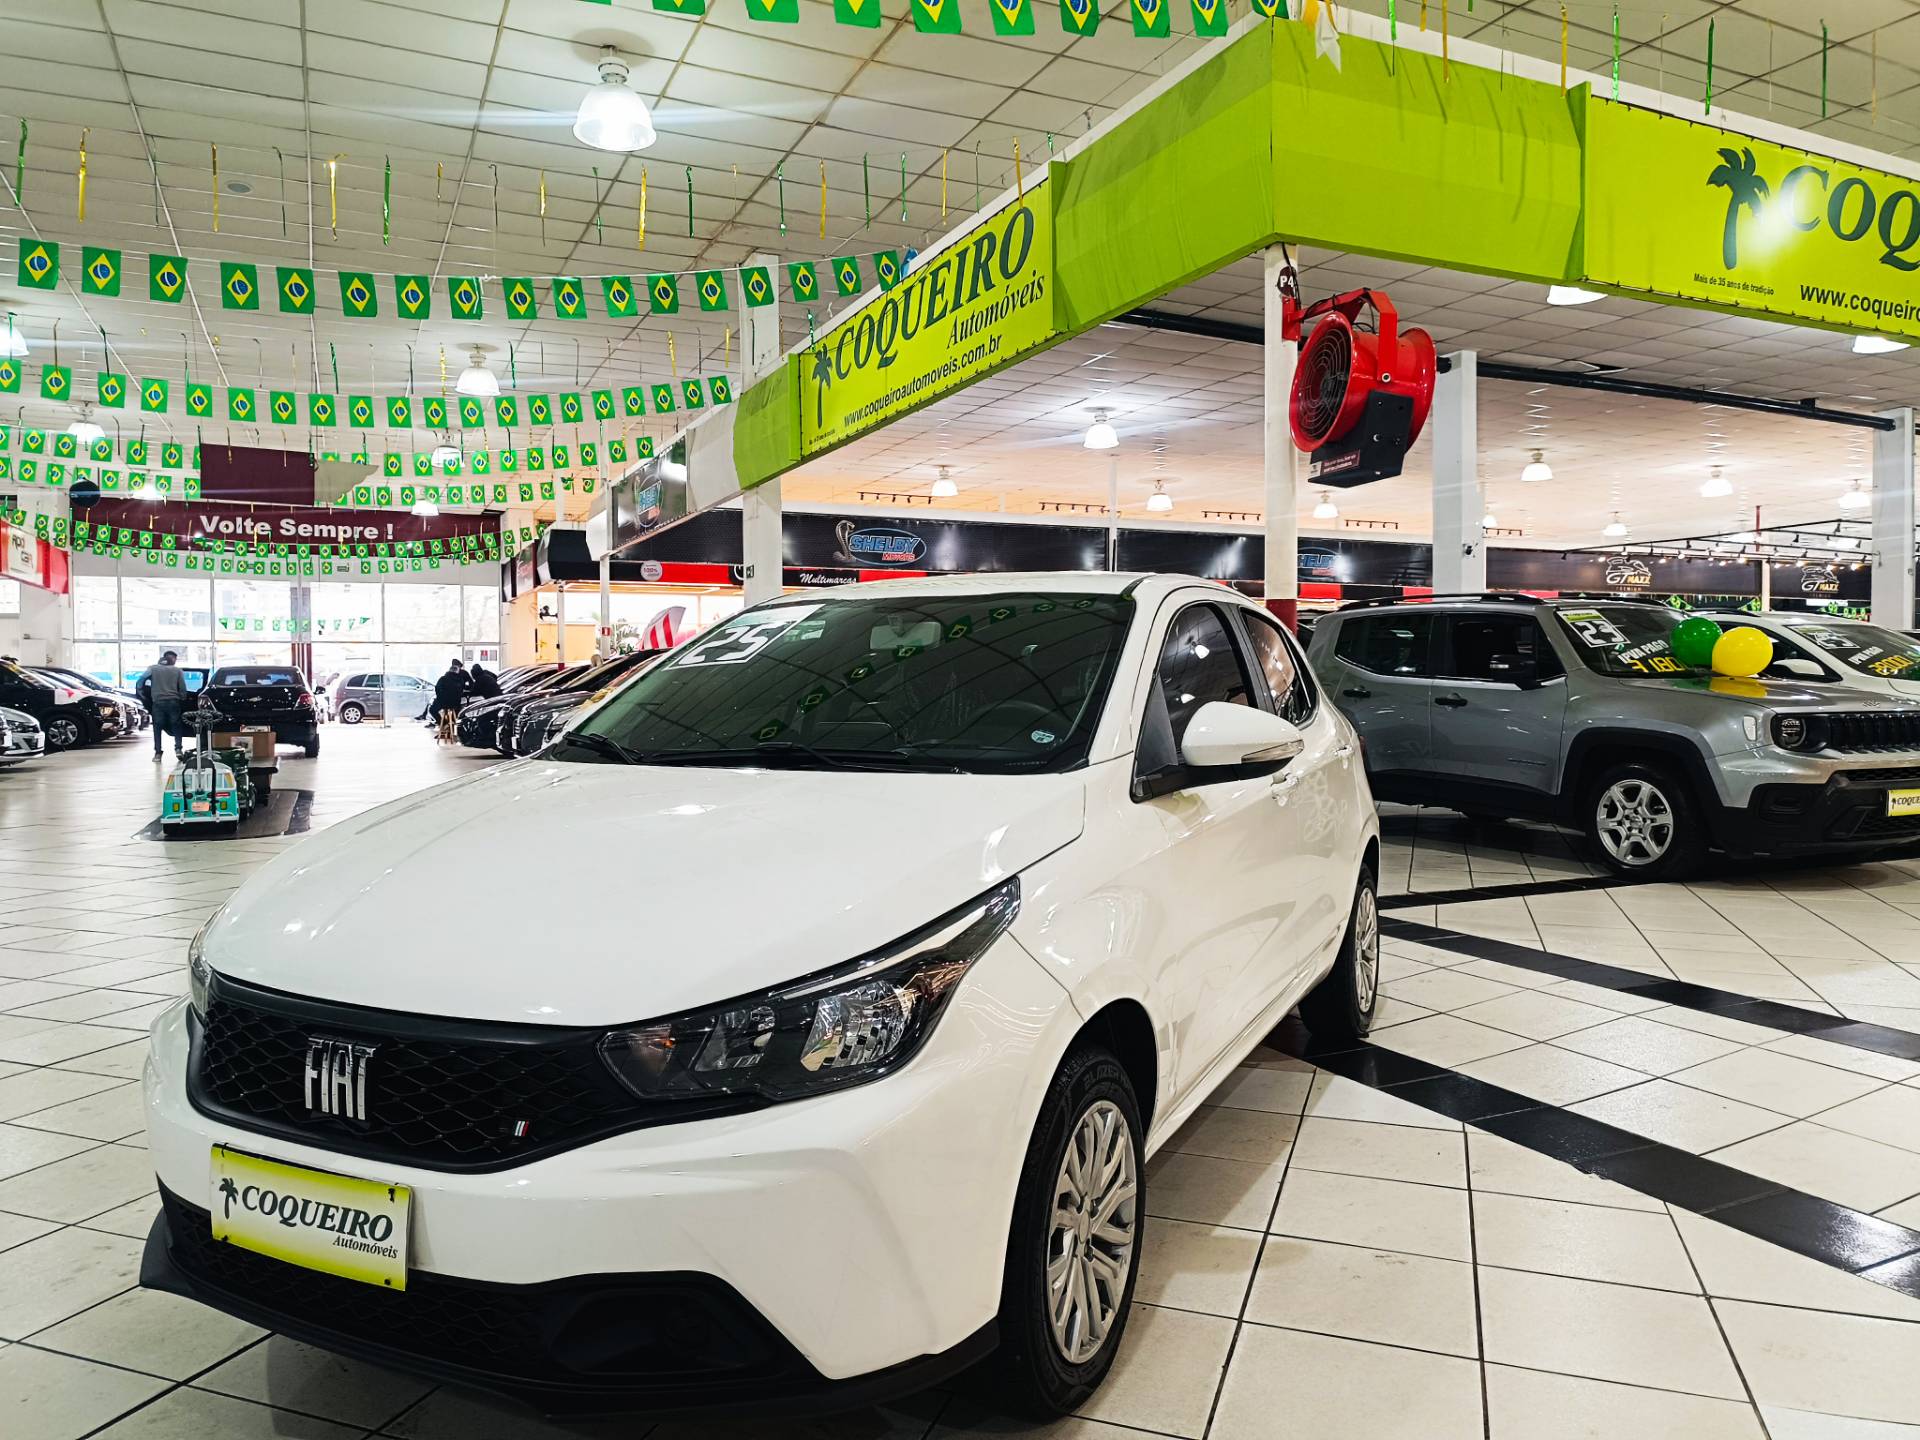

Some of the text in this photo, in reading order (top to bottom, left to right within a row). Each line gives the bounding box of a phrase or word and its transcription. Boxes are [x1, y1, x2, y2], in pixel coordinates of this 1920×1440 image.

[835, 206, 1035, 380] COQUEIRO
[1280, 275, 1294, 288] P4
[1693, 272, 1775, 297] Mais de 35 anos de tradição
[947, 269, 1045, 349] Automóveis
[843, 334, 1003, 426] www.coqueiroautomoveis.com.br
[200, 515, 271, 534] Volte
[279, 518, 379, 542] Sempre
[849, 535, 920, 553] SHELBY
[800, 572, 857, 585] Multimarcas
[678, 621, 797, 665] 25
[1574, 620, 1624, 644] 23
[1643, 639, 1669, 656] PAGO
[305, 1037, 376, 1120] FIAT
[242, 1185, 393, 1243] COQUEIRO
[332, 1235, 399, 1260] Automóveis
